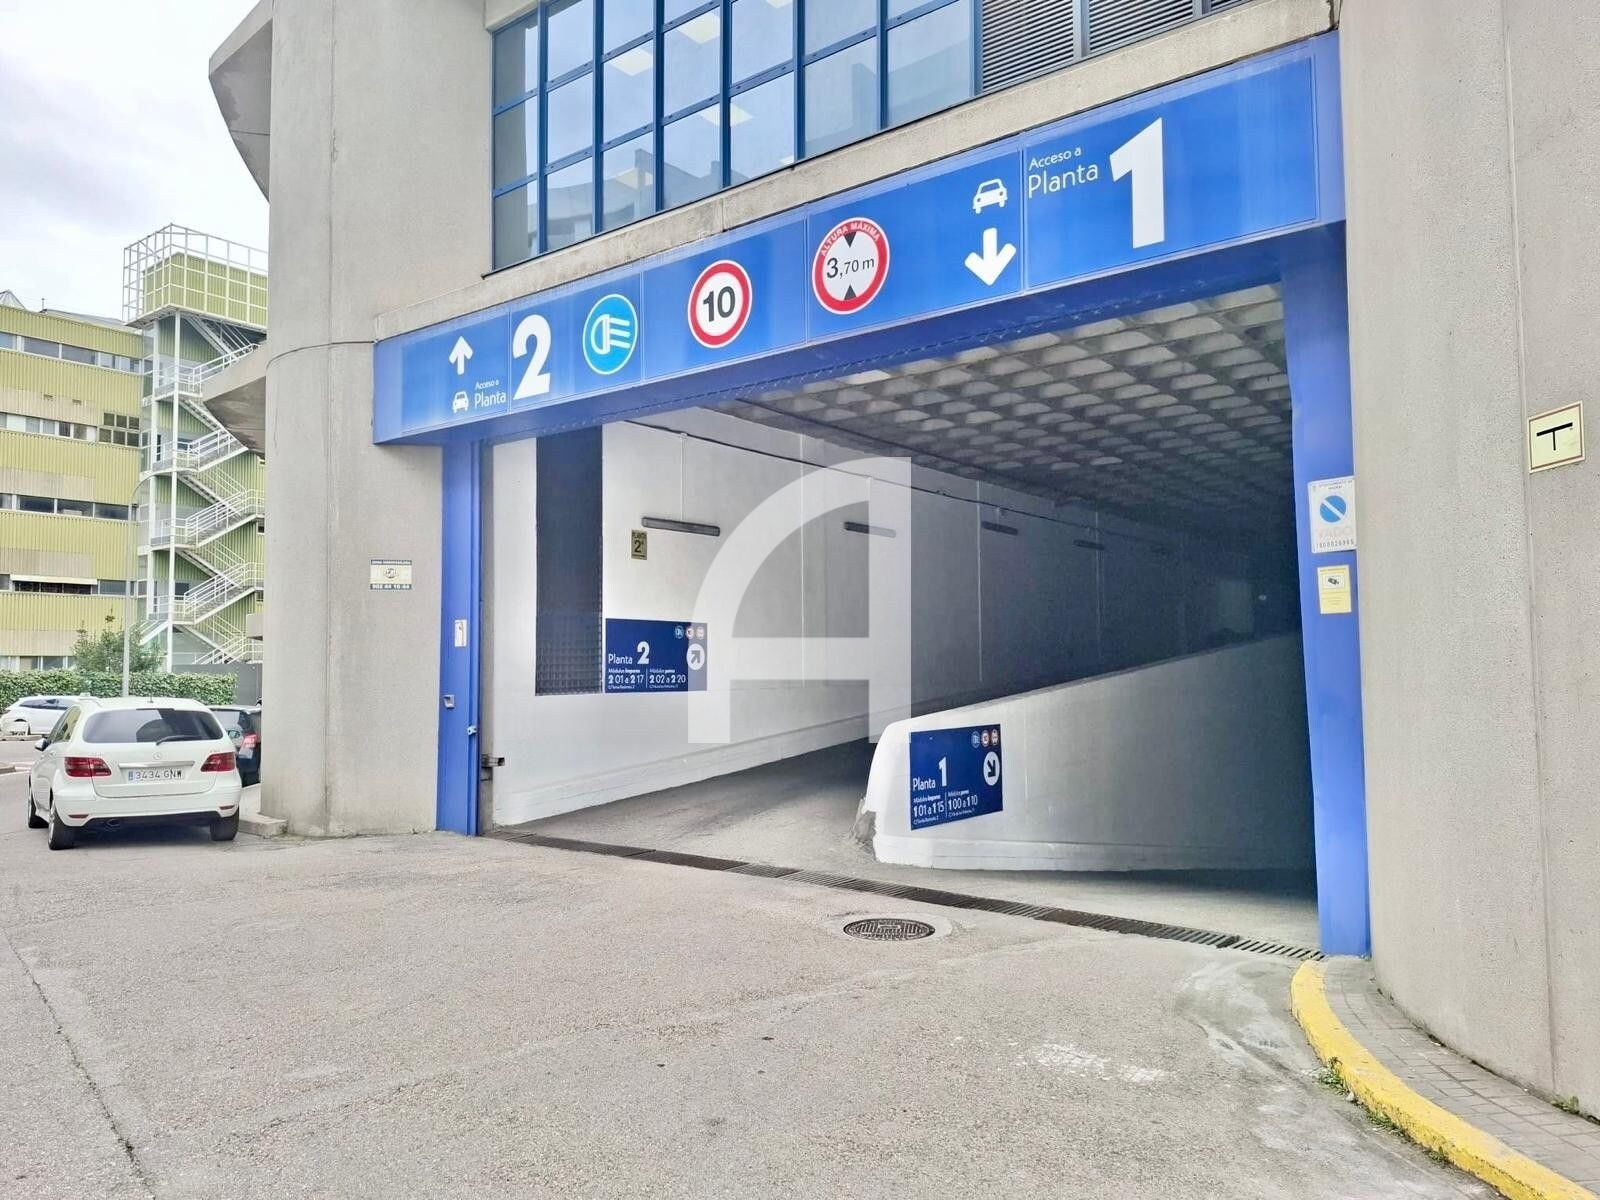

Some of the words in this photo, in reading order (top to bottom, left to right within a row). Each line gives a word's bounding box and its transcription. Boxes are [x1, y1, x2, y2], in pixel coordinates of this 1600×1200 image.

[1028, 150, 1072, 171] Acceso
[1074, 147, 1082, 158] a
[1027, 164, 1099, 199] Planta
[1109, 116, 1165, 249] 1
[821, 224, 849, 257] ALTURA
[850, 220, 881, 242] MÁXIMA
[826, 257, 860, 280] 3,70
[862, 258, 875, 270] m
[702, 285, 736, 323] 10
[474, 390, 507, 409] Planta
[512, 313, 552, 401] 2
[475, 380, 495, 390] Acceso
[608, 653, 633, 665] Planta
[637, 641, 650, 665] 2
[135, 770, 160, 780] 3434
[912, 776, 936, 792] Planta
[938, 756, 948, 787] 1
